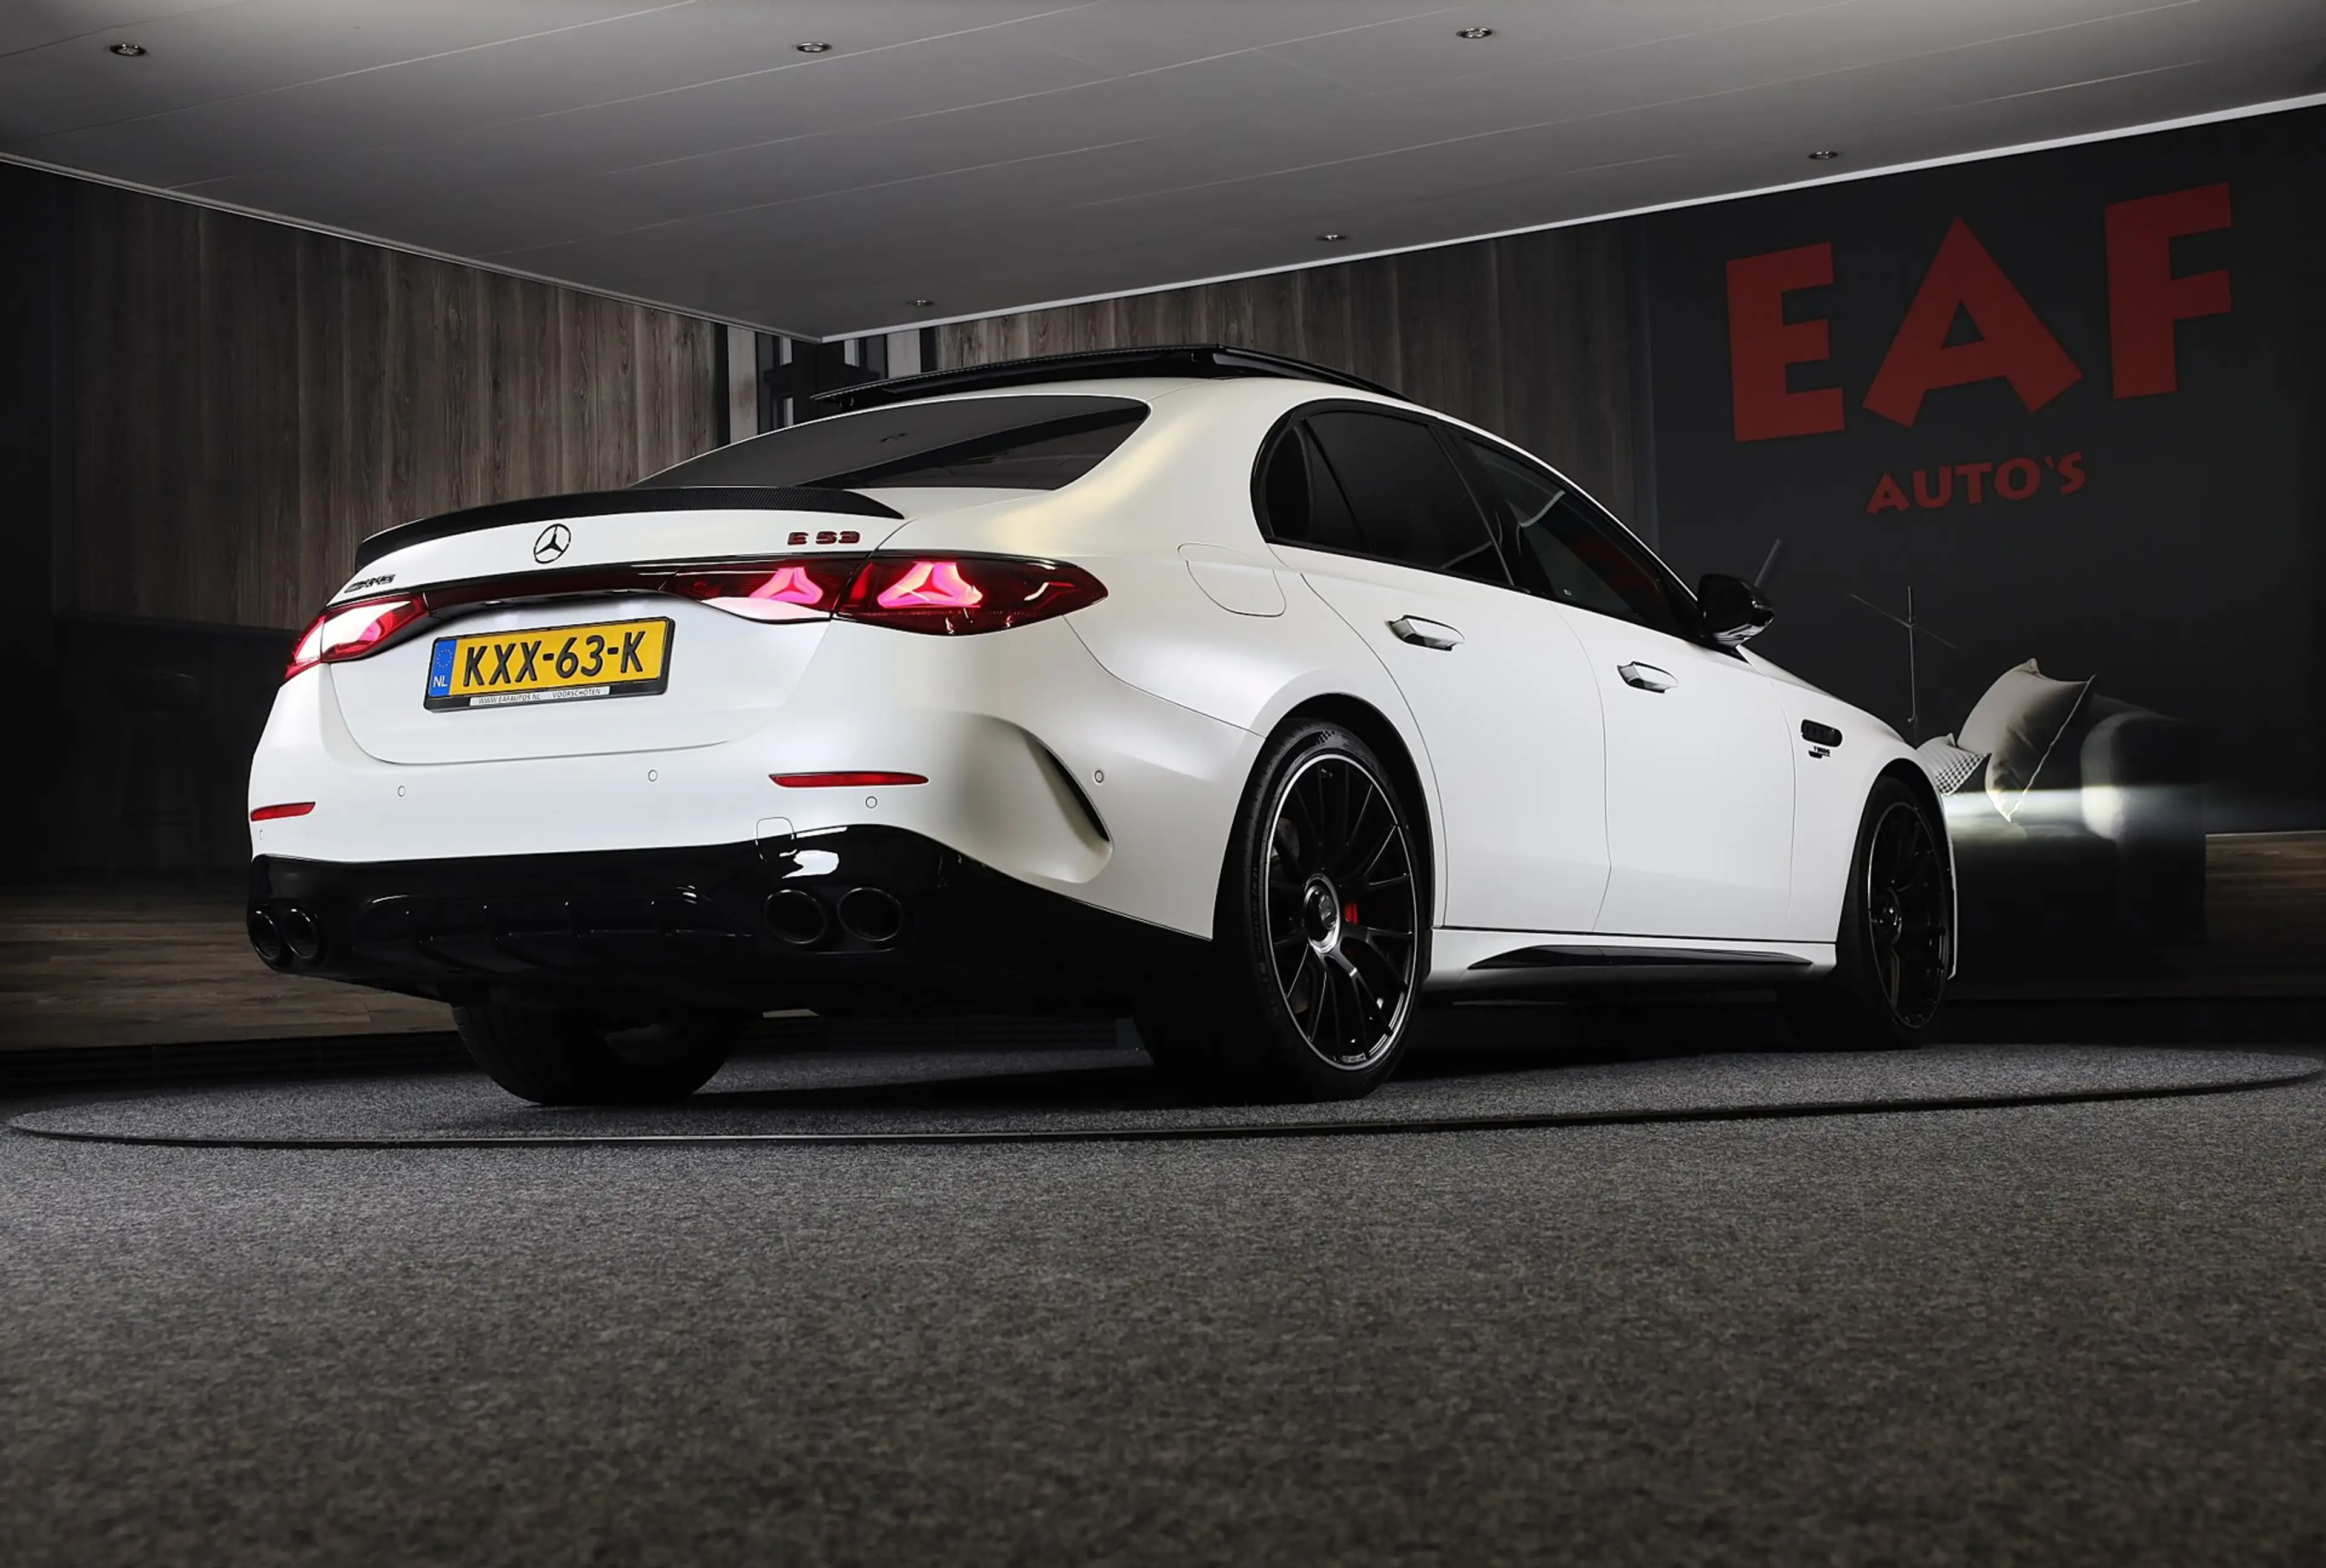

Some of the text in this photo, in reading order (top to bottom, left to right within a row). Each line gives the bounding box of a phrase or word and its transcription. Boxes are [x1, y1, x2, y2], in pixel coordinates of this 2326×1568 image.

[1726, 182, 2232, 442] EAF
[1866, 451, 2086, 515] AUTO'S
[787, 531, 860, 545] E 53
[432, 675, 448, 687] NL
[463, 631, 646, 686] KXX-63-K
